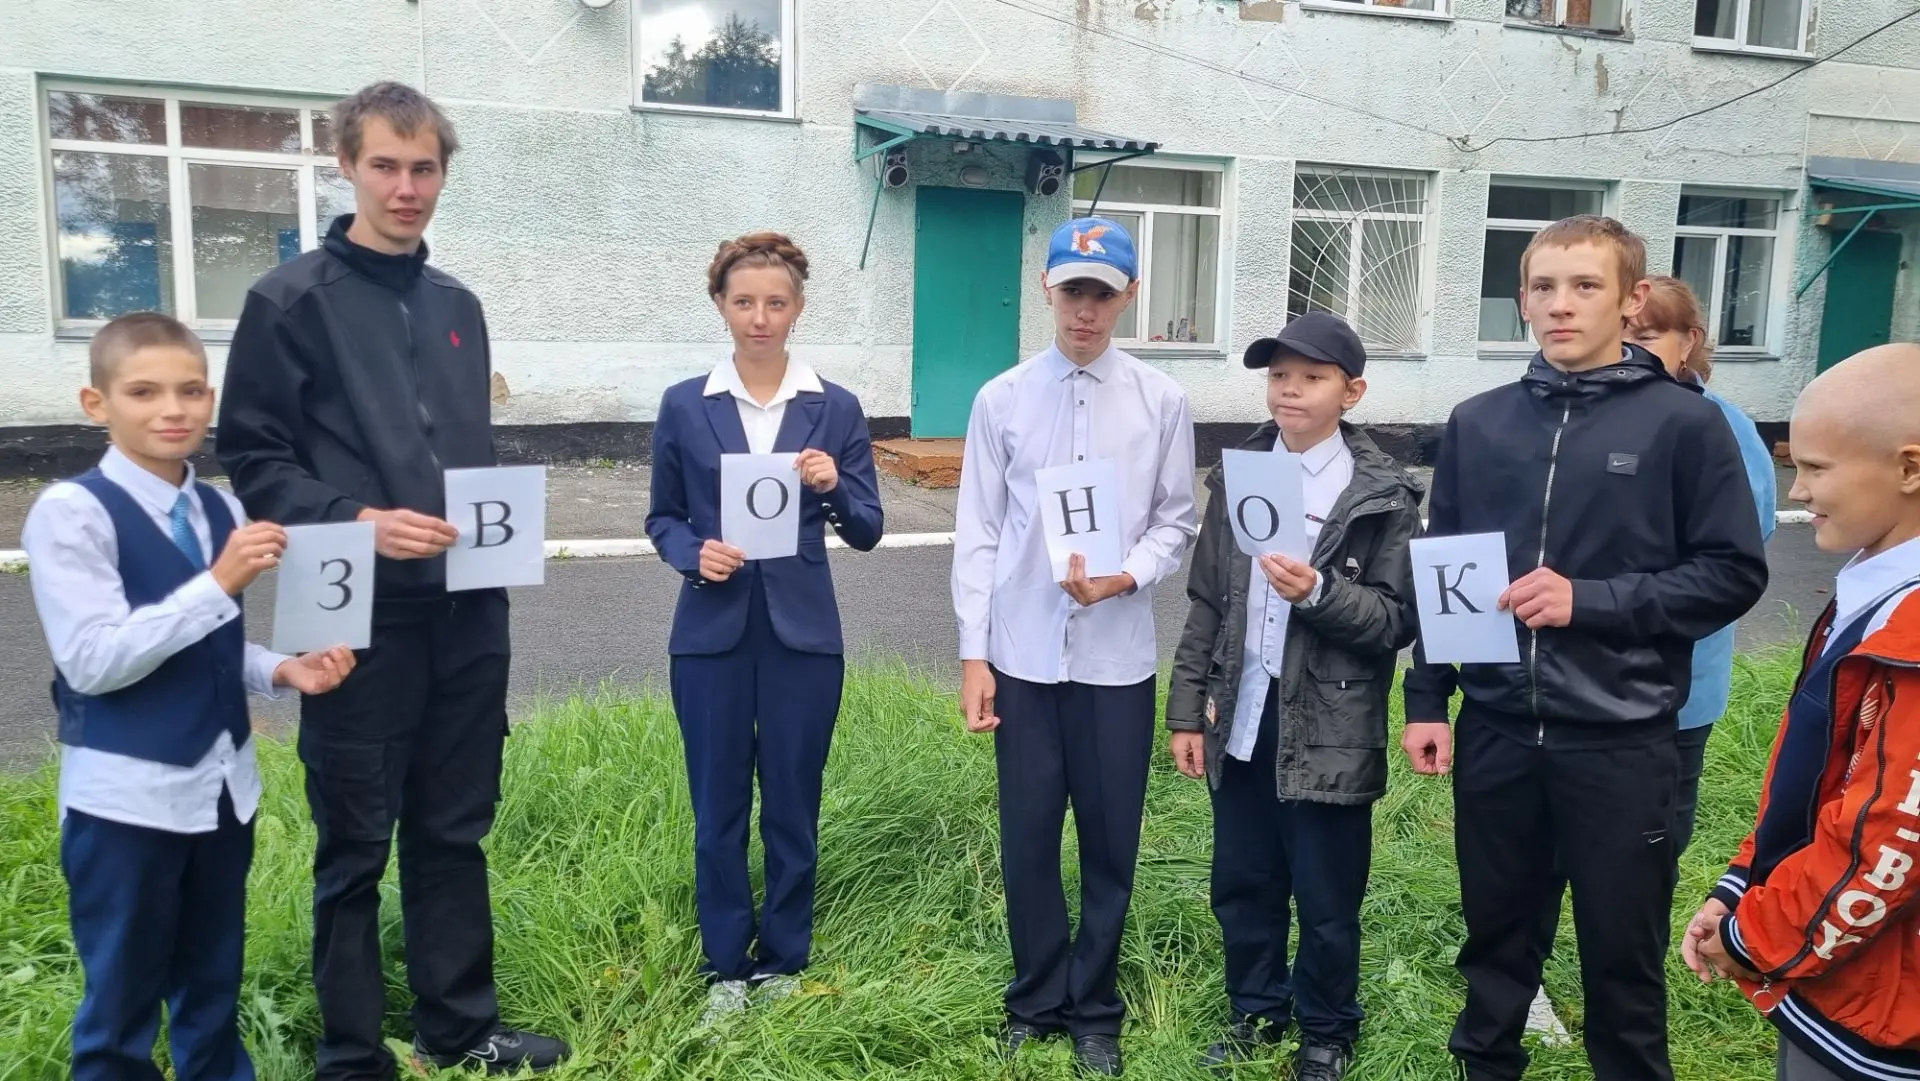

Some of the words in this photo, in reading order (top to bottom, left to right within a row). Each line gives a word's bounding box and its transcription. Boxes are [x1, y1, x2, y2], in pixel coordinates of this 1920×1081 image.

[747, 477, 788, 520] О
[1055, 486, 1100, 535] Н
[1237, 495, 1280, 541] О
[469, 501, 514, 548] В
[1431, 563, 1484, 615] К
